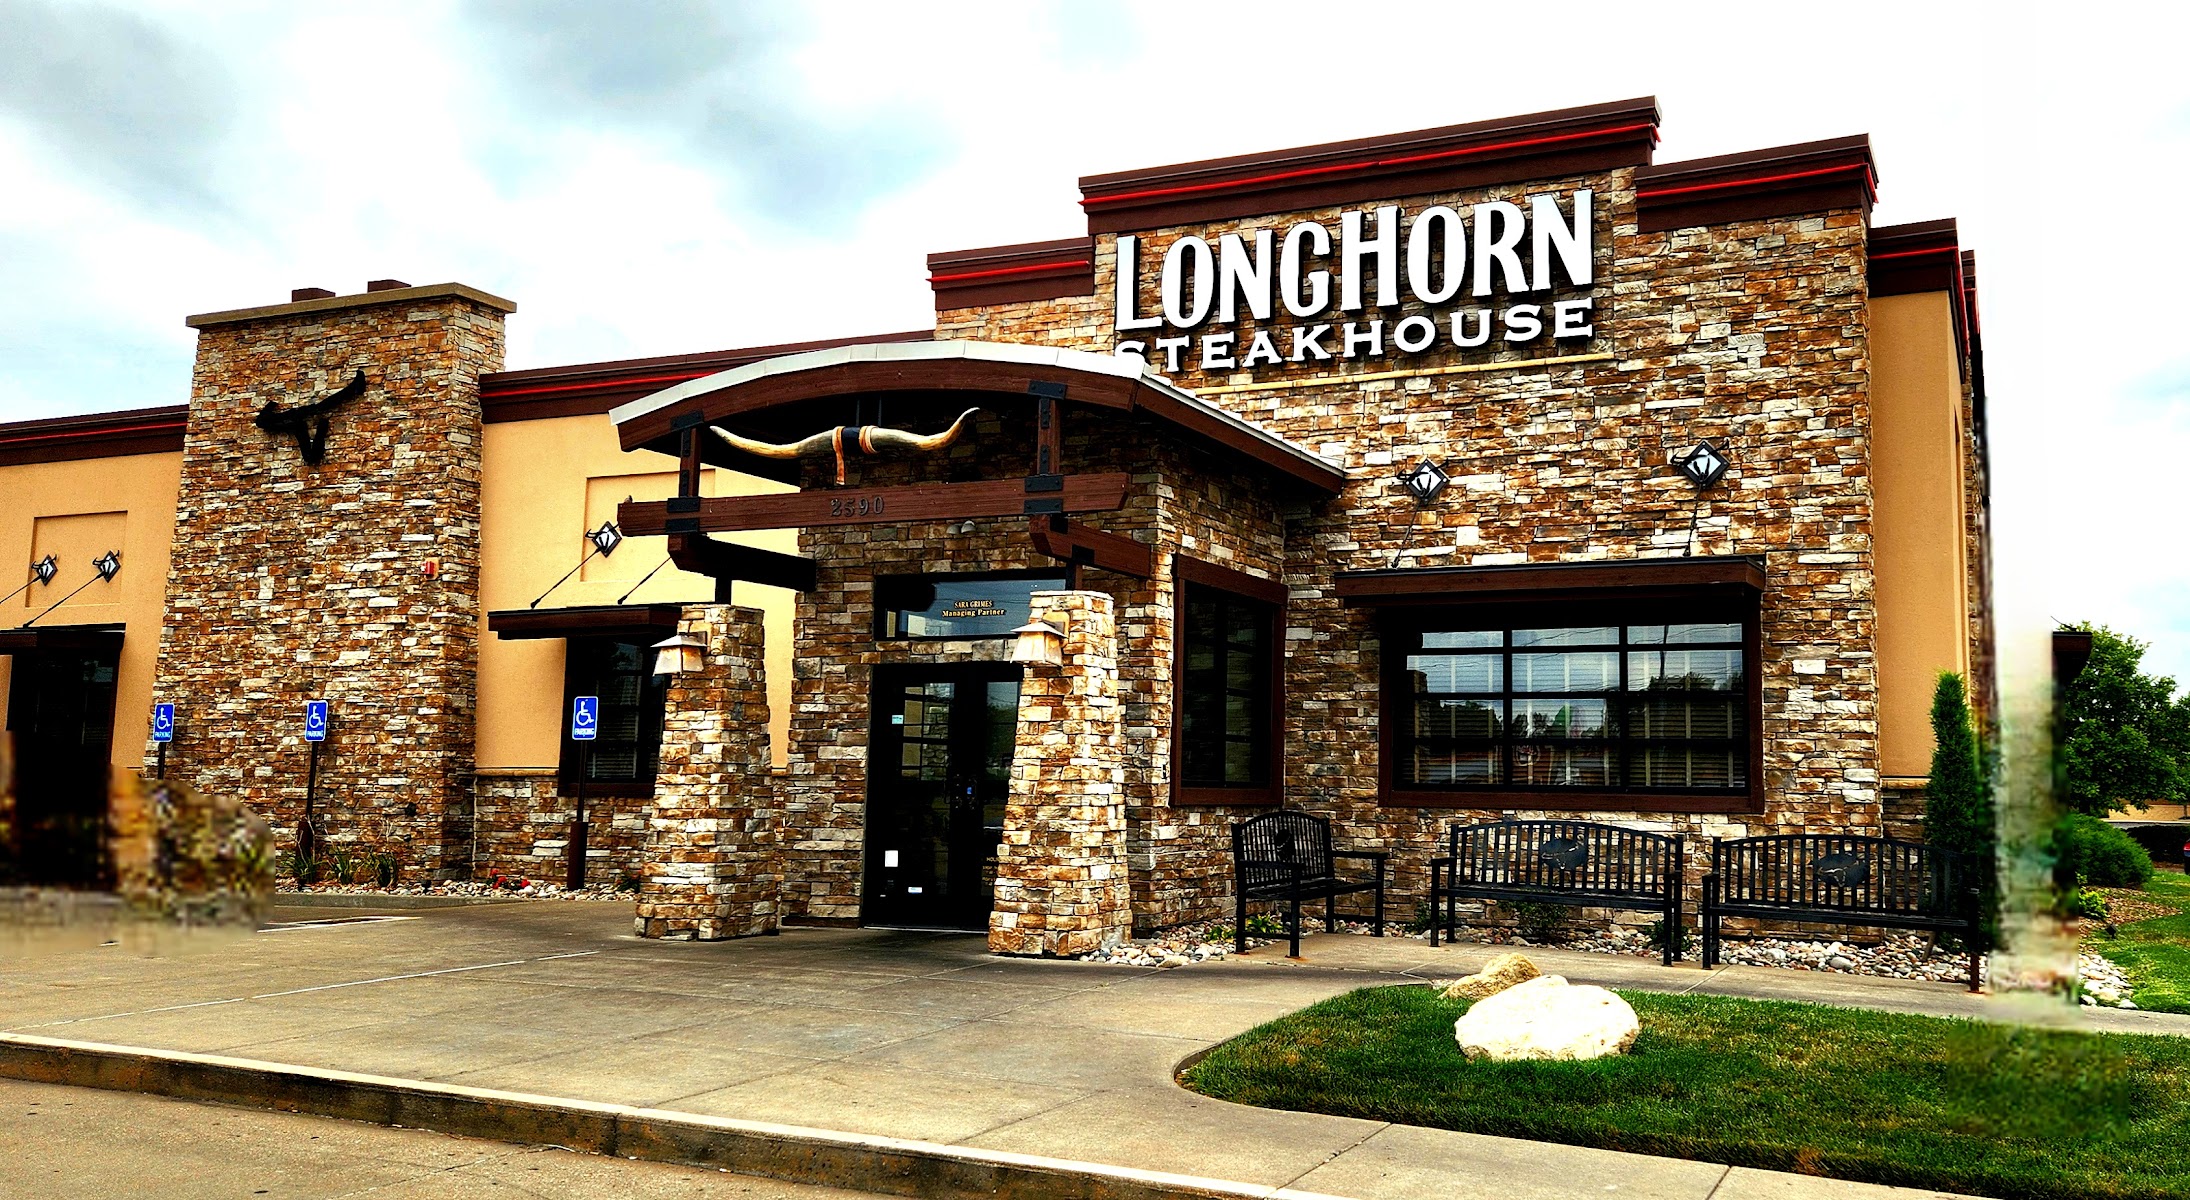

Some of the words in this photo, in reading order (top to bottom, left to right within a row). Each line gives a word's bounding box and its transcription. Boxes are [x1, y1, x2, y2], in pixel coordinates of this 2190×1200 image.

[1114, 189, 1595, 332] LONGHORN
[830, 496, 884, 516] 2590
[942, 610, 976, 618] Managing
